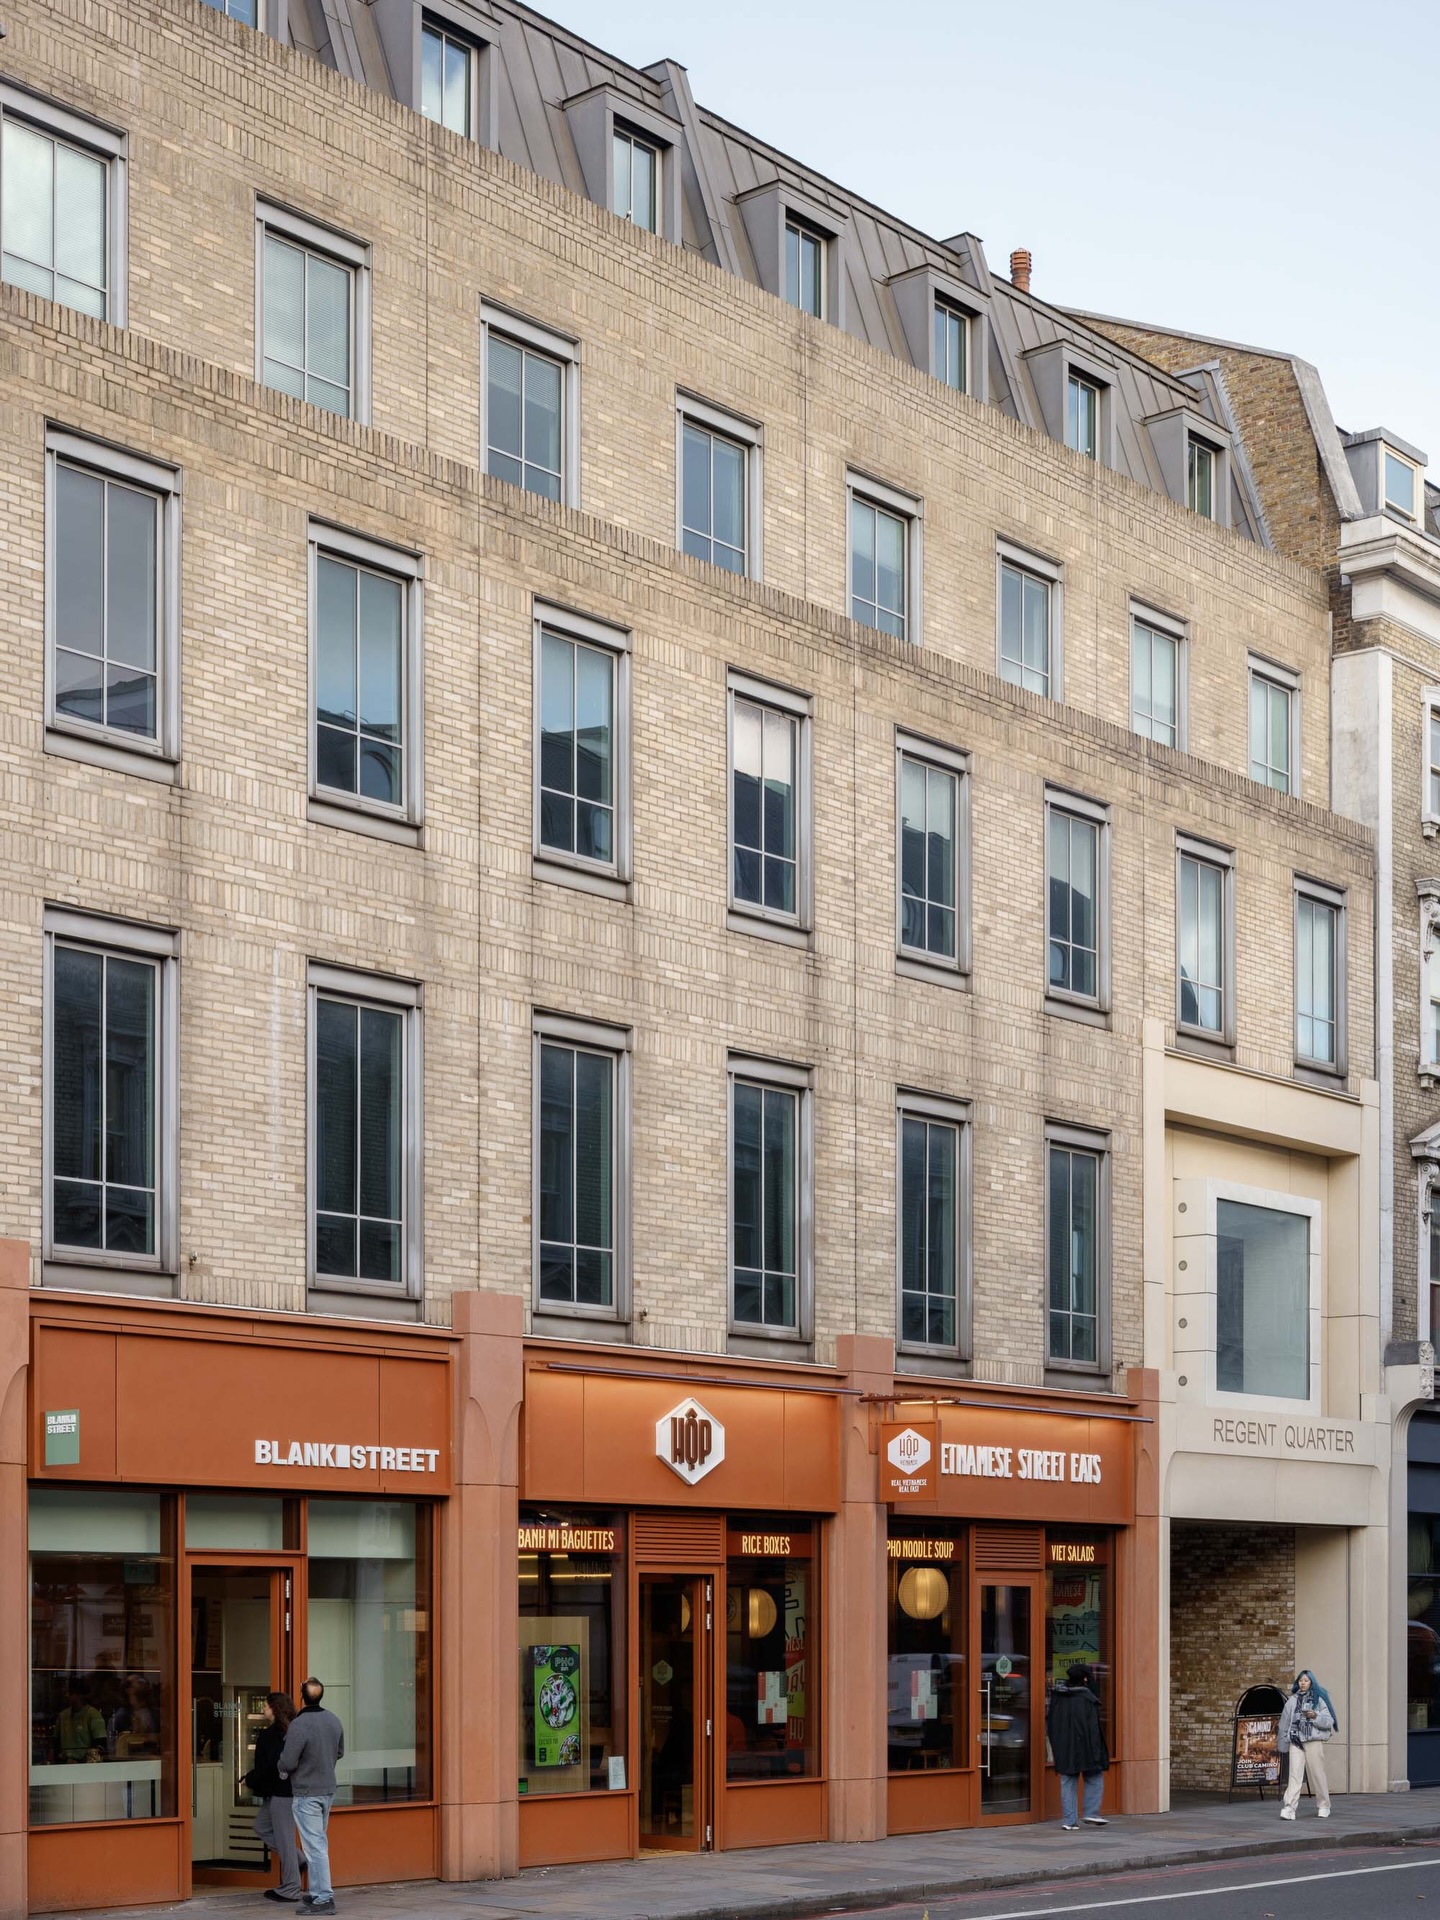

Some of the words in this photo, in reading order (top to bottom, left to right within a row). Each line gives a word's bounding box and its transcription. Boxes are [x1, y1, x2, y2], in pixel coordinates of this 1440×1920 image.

[47, 1415, 72, 1424] BLANK
[47, 1424, 76, 1433] STREET
[1213, 1419, 1277, 1446] REGENT
[1284, 1425, 1354, 1452] QUARTER
[255, 1440, 335, 1467] BLANK
[351, 1445, 440, 1472] STREET
[941, 1443, 1013, 1478] ETNAMESE
[1017, 1449, 1066, 1480] STREET
[1070, 1453, 1101, 1484] EATS
[518, 1528, 546, 1549] BANH
[548, 1529, 559, 1549] MI
[561, 1529, 614, 1550] BAGUETTES
[742, 1535, 762, 1554] RICE
[763, 1536, 791, 1555] BOXES
[886, 1540, 901, 1557] PHO
[903, 1540, 933, 1558] NOODLE
[934, 1541, 954, 1558] SOUP
[1051, 1545, 1066, 1561] VIET
[1067, 1545, 1095, 1562] SALADS
[213, 1710, 242, 1718] STREE
